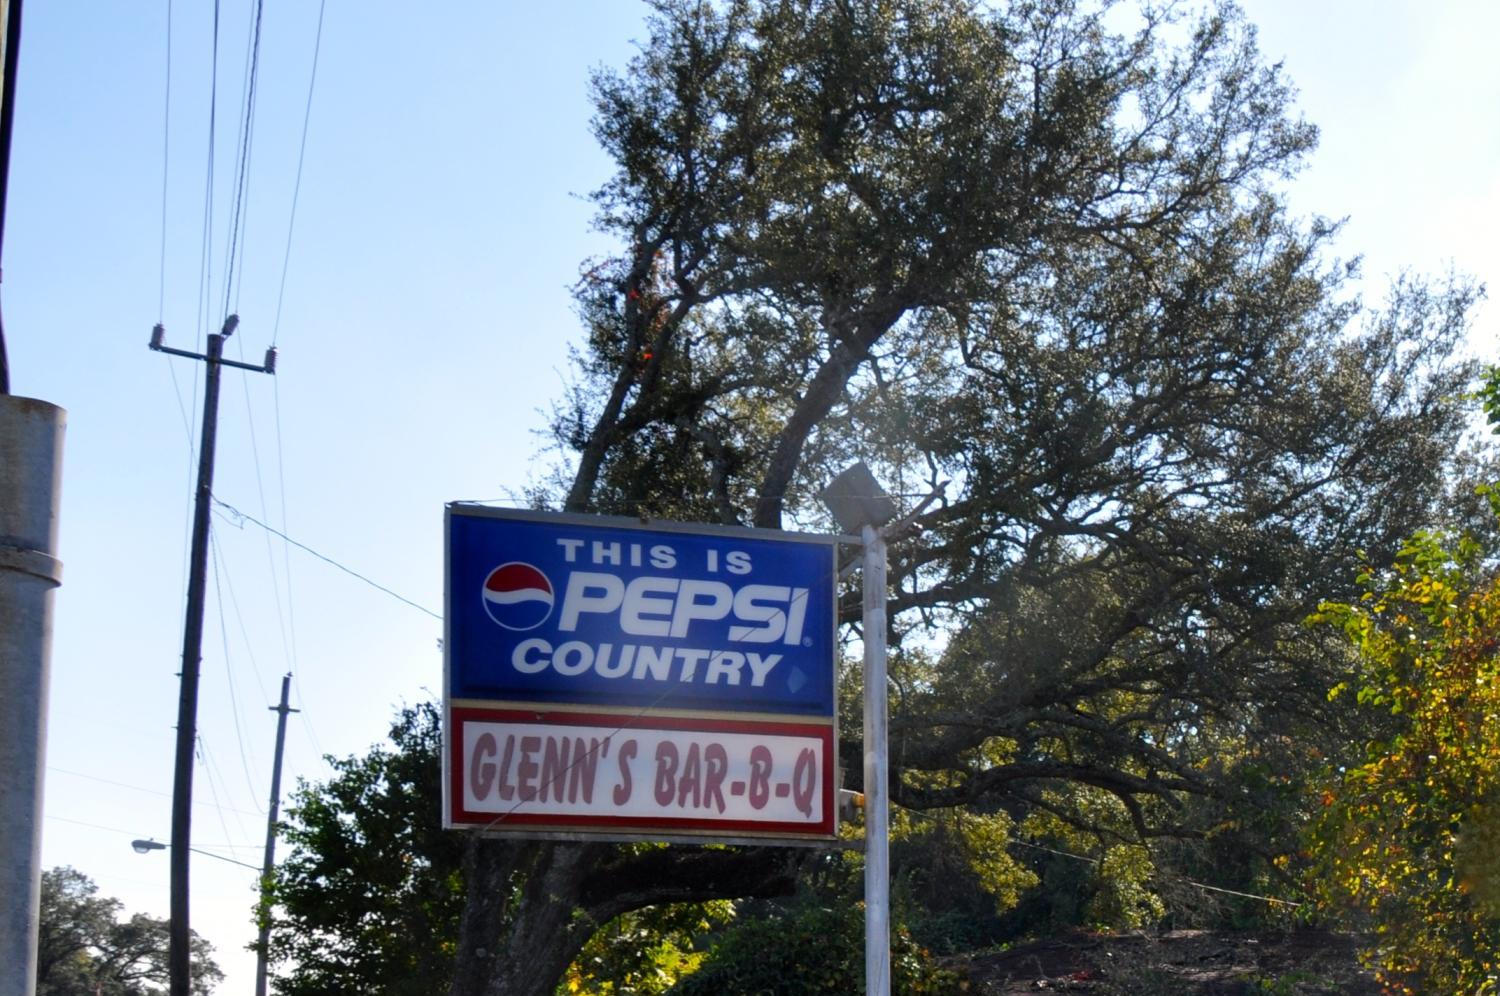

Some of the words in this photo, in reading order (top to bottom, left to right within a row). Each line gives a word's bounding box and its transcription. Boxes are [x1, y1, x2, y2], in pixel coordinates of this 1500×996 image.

[557, 538, 677, 569] THIS
[708, 550, 752, 575] IS
[558, 571, 809, 646] PEPSI
[512, 638, 782, 687] COUNTRY
[470, 732, 638, 806] GLENN'S
[654, 740, 816, 819] BAR-B-Q
